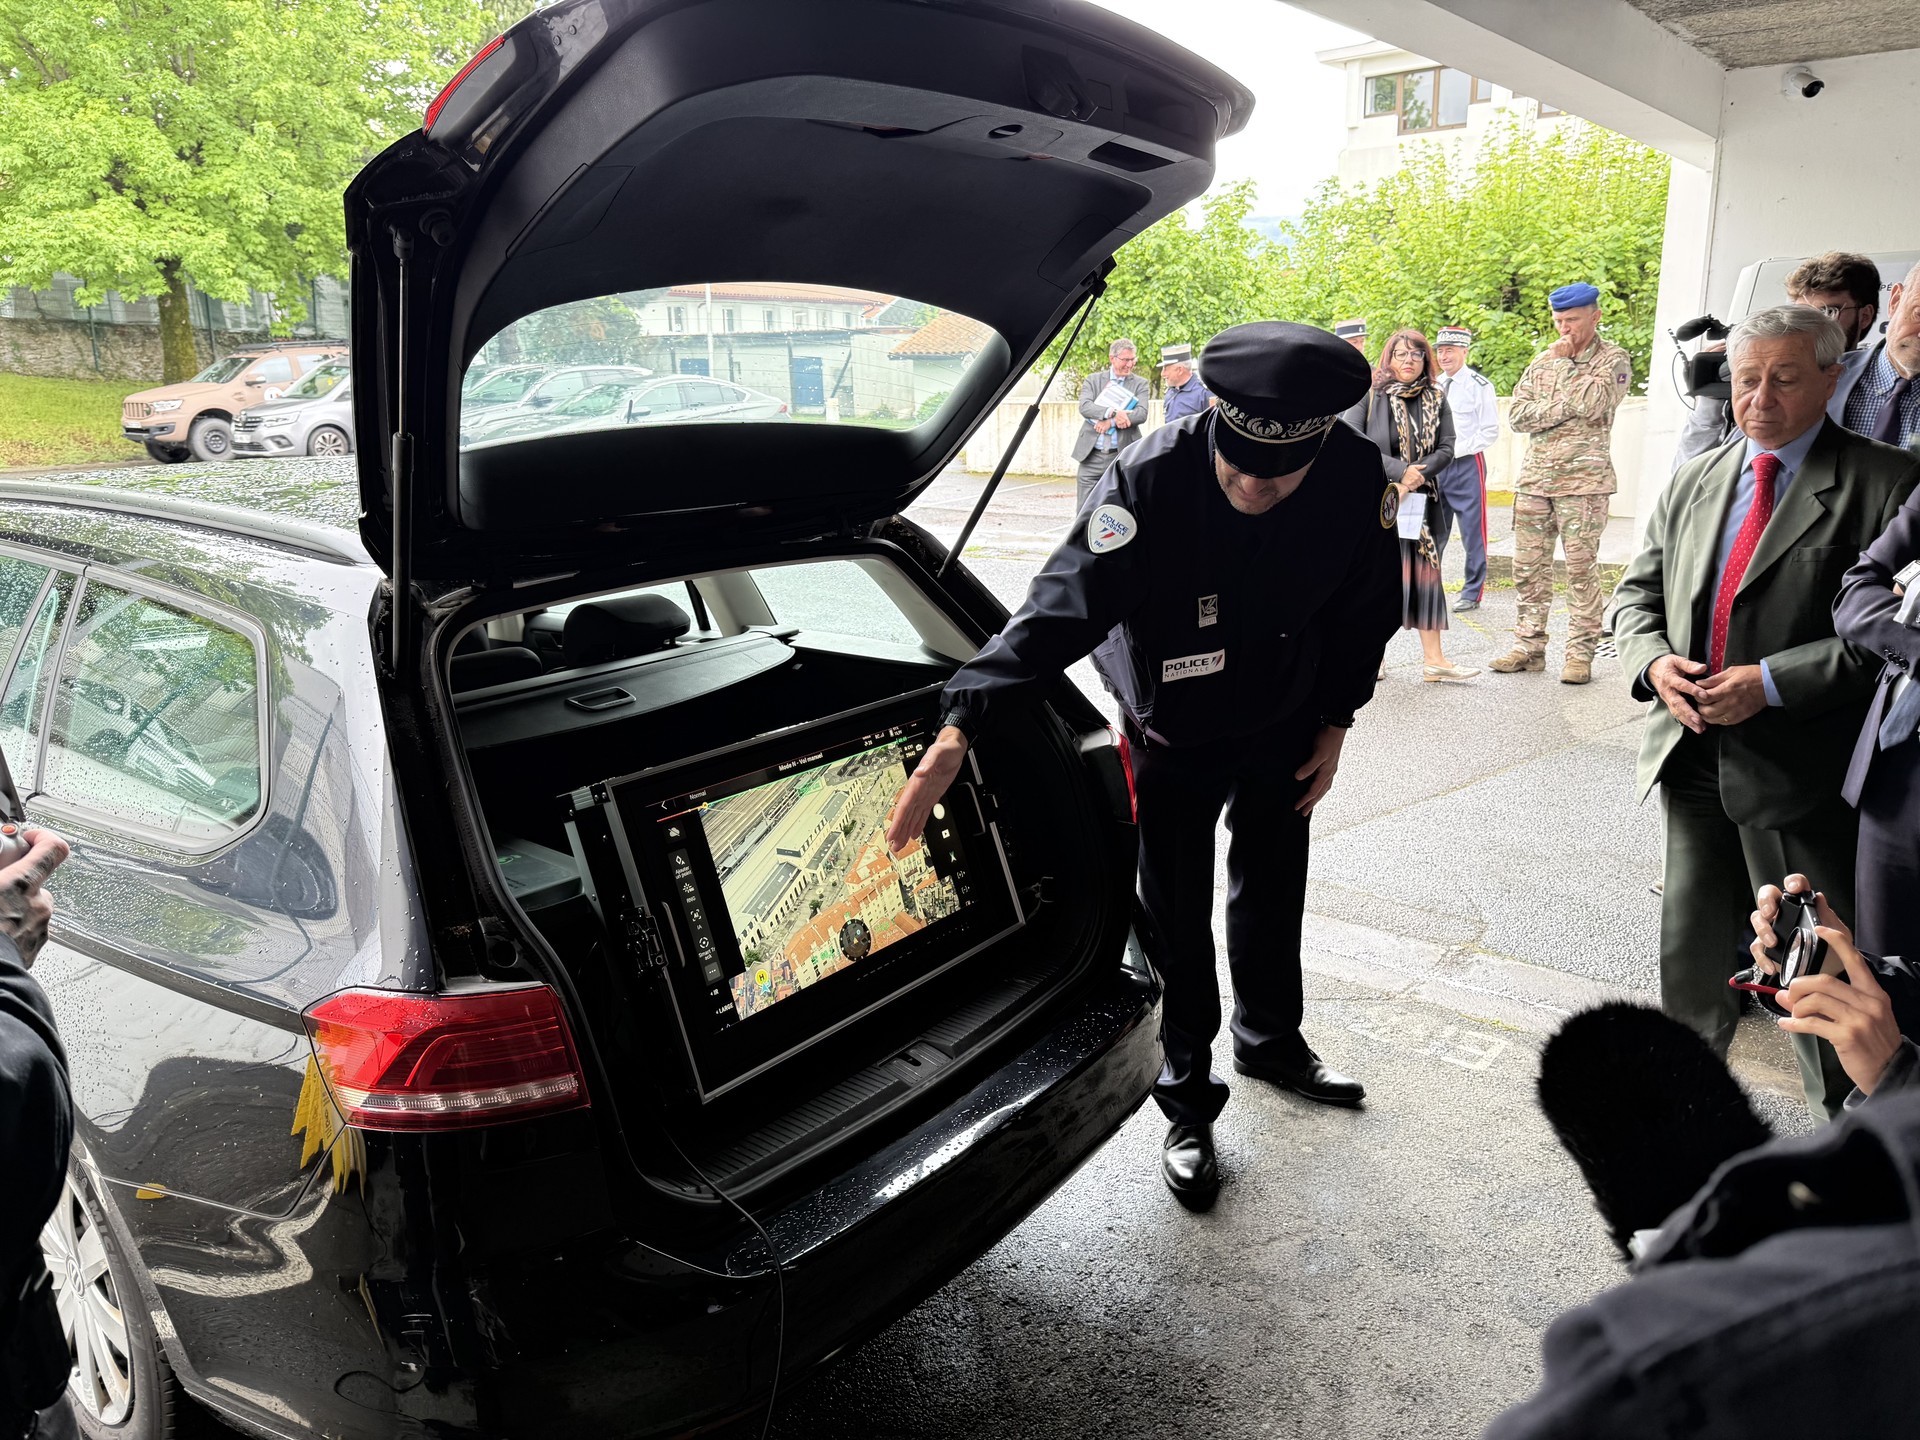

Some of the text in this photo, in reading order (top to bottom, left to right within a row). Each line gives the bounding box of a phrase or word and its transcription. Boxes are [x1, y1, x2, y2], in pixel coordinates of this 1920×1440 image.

[1099, 517, 1126, 536] NATIONALE
[1101, 513, 1129, 532] POLICE
[1165, 658, 1209, 672] POLICE
[1164, 667, 1209, 678] NATIONALE
[778, 763, 792, 772] Mode
[807, 752, 823, 762] manuel
[689, 790, 707, 801] Normal
[718, 1002, 734, 1014] LARGE
